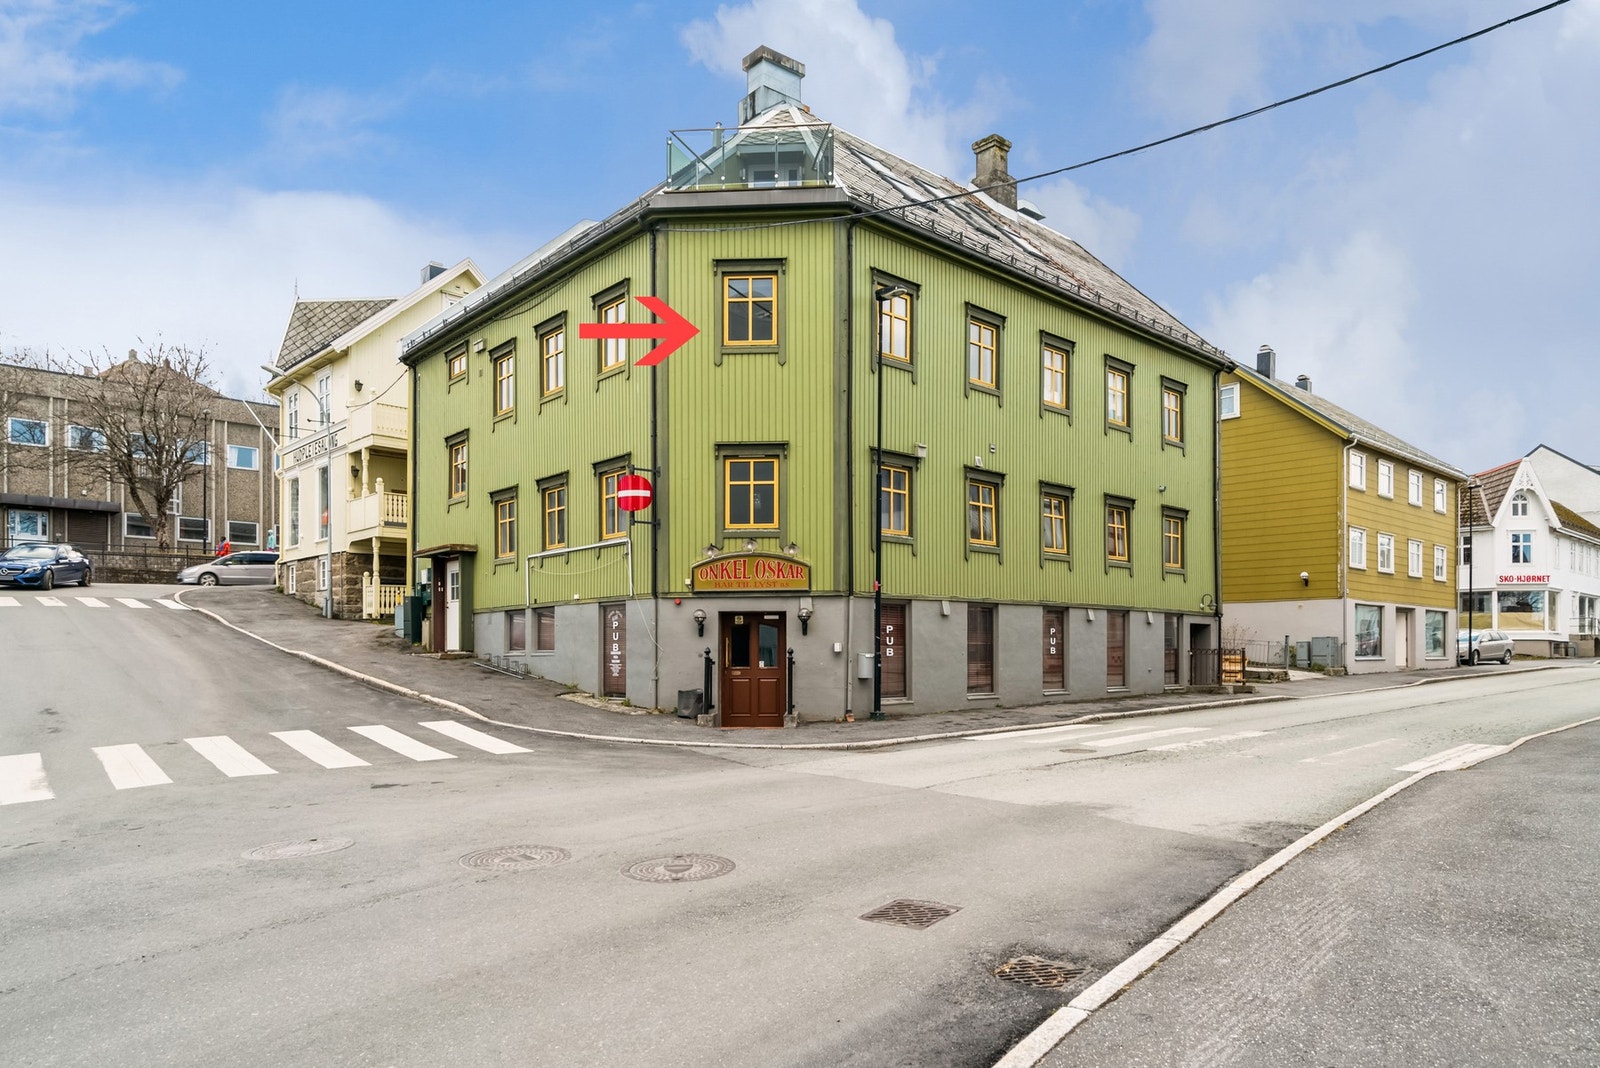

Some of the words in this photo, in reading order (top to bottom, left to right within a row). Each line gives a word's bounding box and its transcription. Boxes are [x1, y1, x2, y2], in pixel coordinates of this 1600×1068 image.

[699, 558, 752, 581] ONKEL
[754, 558, 806, 581] OSKAR
[886, 625, 894, 657] PUB
